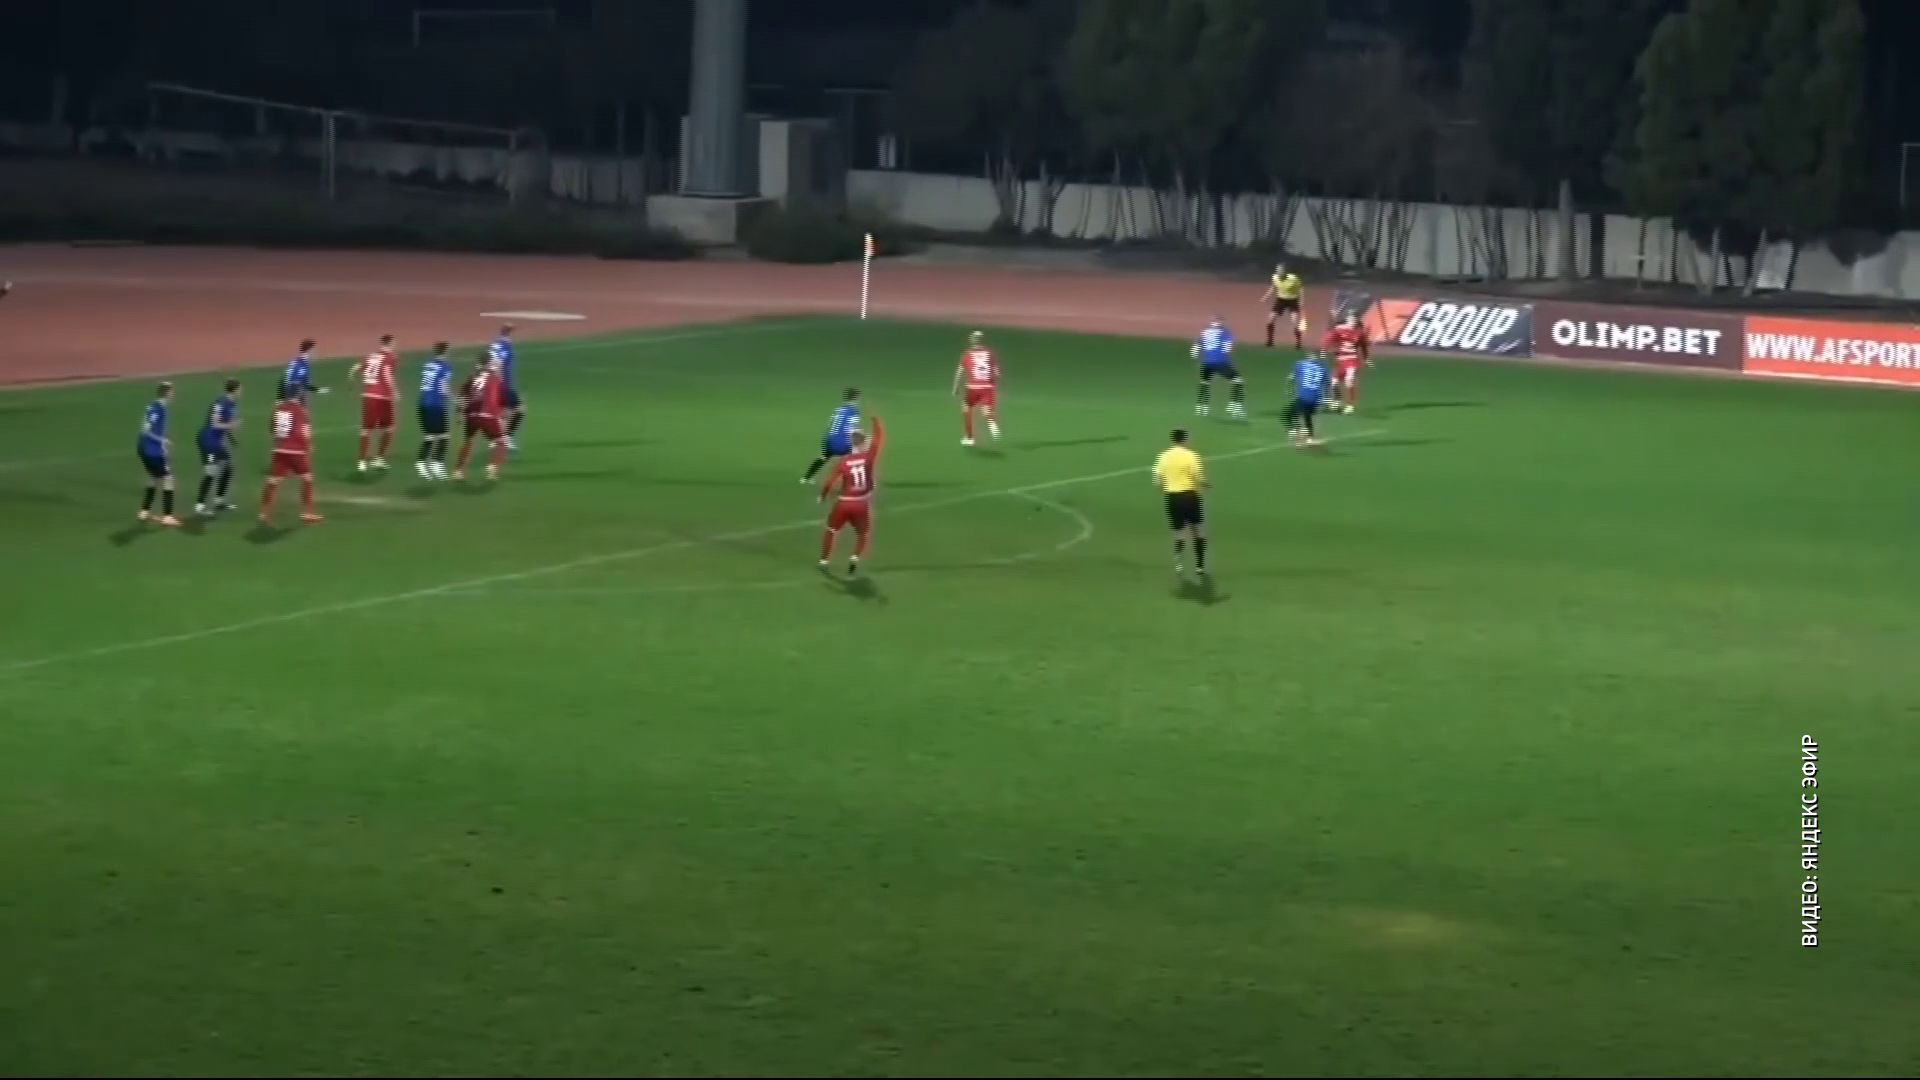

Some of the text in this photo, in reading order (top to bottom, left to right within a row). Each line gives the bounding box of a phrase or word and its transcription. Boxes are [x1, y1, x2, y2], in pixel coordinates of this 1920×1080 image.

[1399, 302, 1519, 350] GROUP
[1551, 319, 1722, 356] OLIMP.BET
[850, 464, 867, 491] 11
